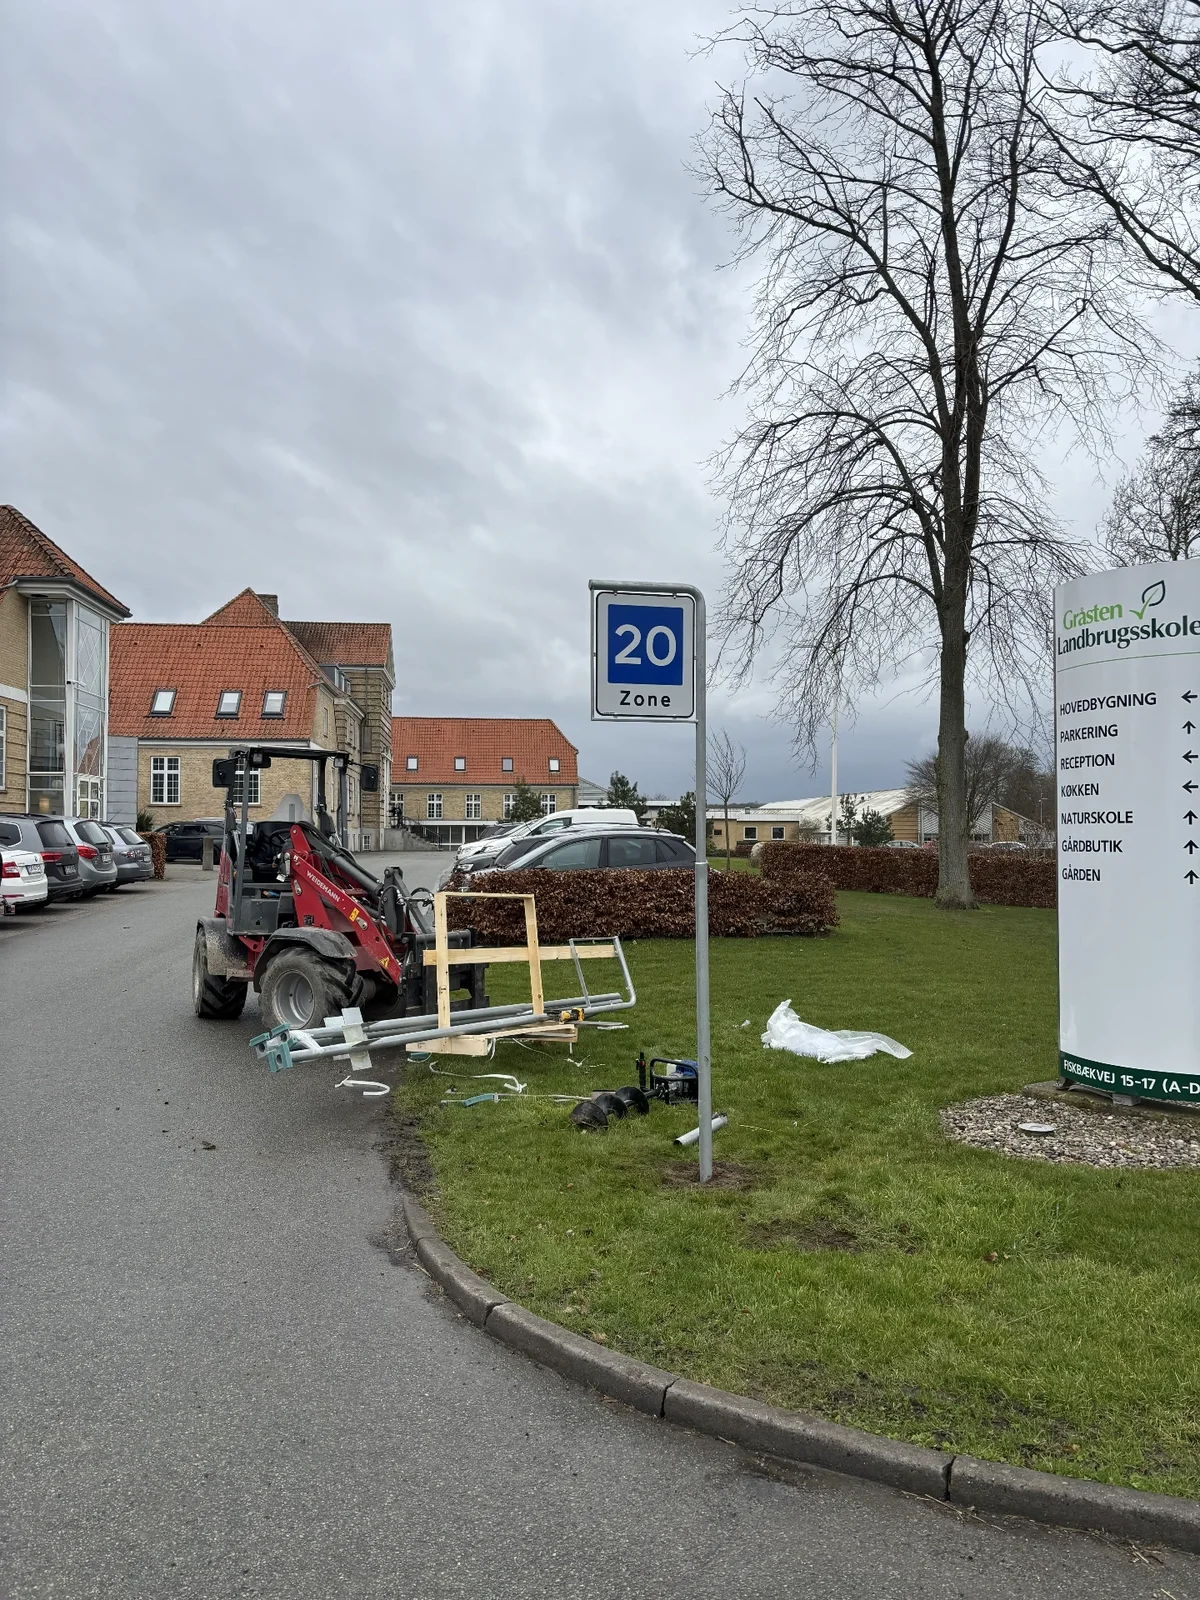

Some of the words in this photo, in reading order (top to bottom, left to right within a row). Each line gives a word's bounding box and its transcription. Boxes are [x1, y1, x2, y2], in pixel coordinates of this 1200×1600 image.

[1063, 603, 1123, 630] Gråsten
[1057, 615, 1200, 655] Landbrugsskole
[614, 623, 677, 667] 20
[619, 690, 671, 707] Zone
[1059, 692, 1157, 716] HOVEDBYGNING
[1060, 724, 1118, 743] PARKERING
[1060, 753, 1115, 770] RECEPTION
[1061, 783, 1099, 797] KØKKEN
[1061, 811, 1133, 825] NATURSKOLE
[1062, 836, 1123, 853] GÅRDBUTIK
[1062, 864, 1101, 882] GÅRDEN
[306, 870, 341, 903] WEIDEMANN
[1063, 1059, 1116, 1084] FISKBÆKVEJ
[1120, 1074, 1156, 1090] 15-17
